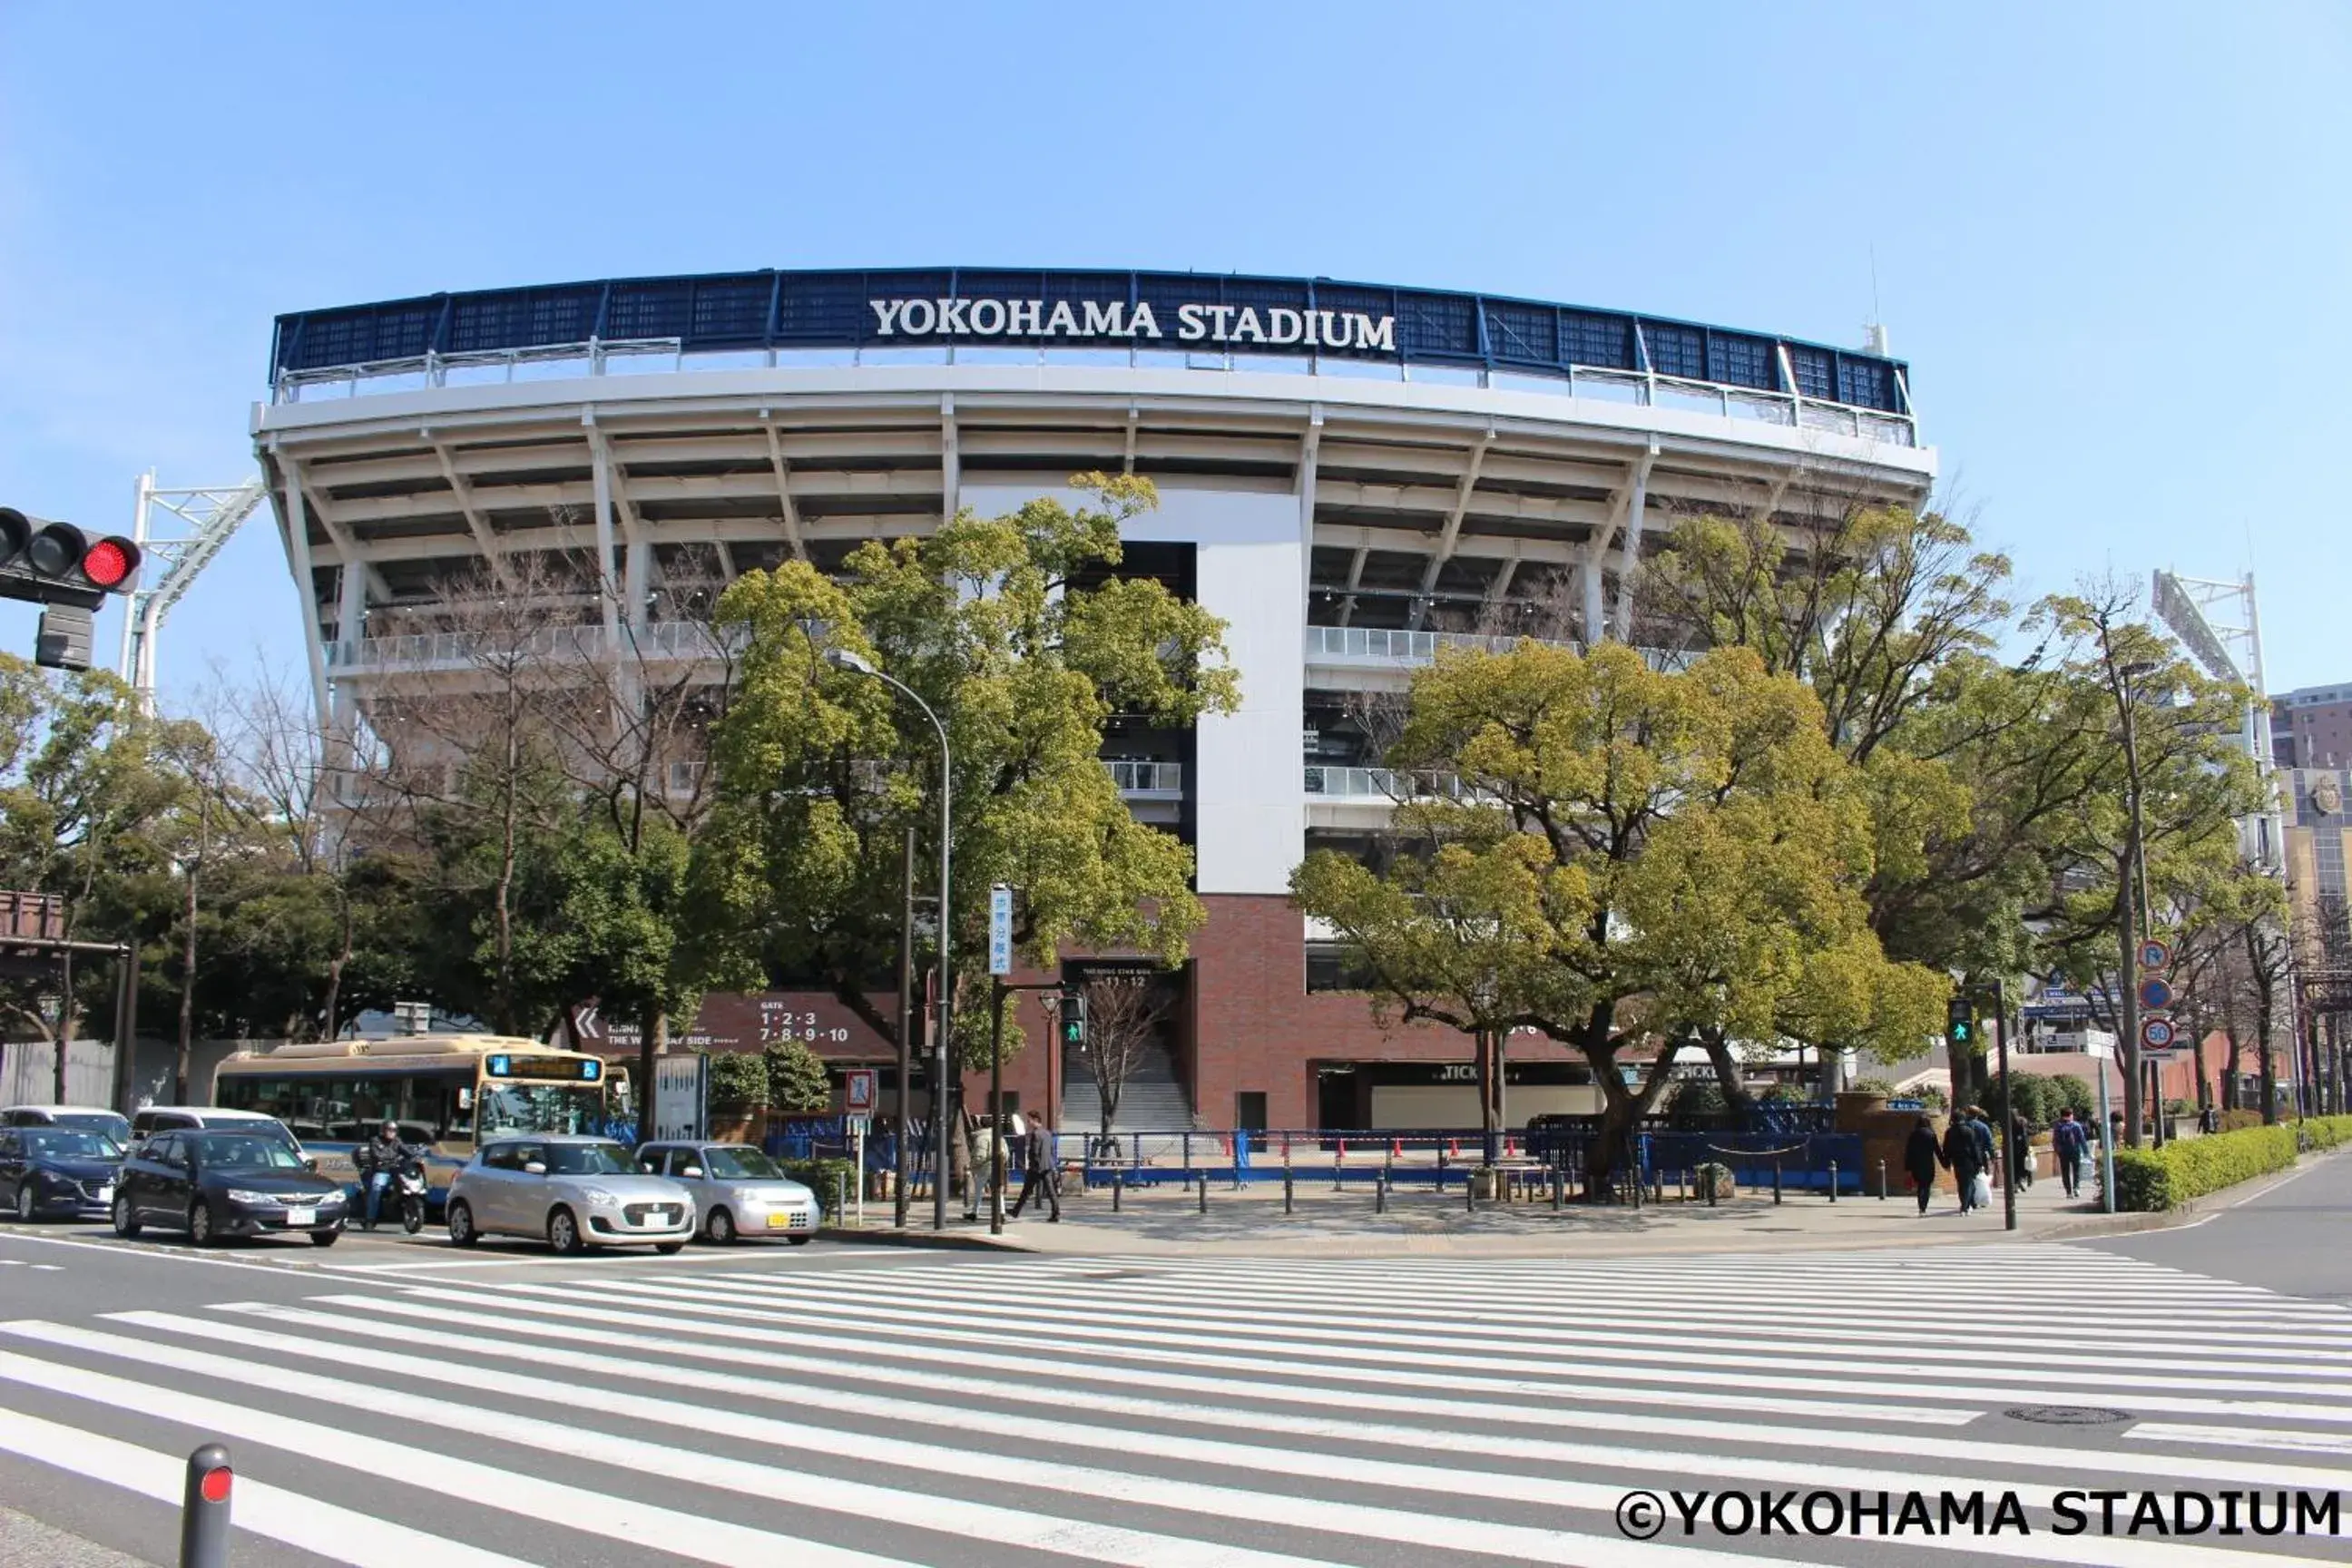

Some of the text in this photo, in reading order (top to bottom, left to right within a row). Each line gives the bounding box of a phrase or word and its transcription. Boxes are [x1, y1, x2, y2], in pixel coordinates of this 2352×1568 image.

[869, 297, 1396, 352] YOKOHAMA STADIUM
[760, 1002, 784, 1010] GATE
[607, 1035, 628, 1045] THE
[687, 1035, 711, 1045] SIDE
